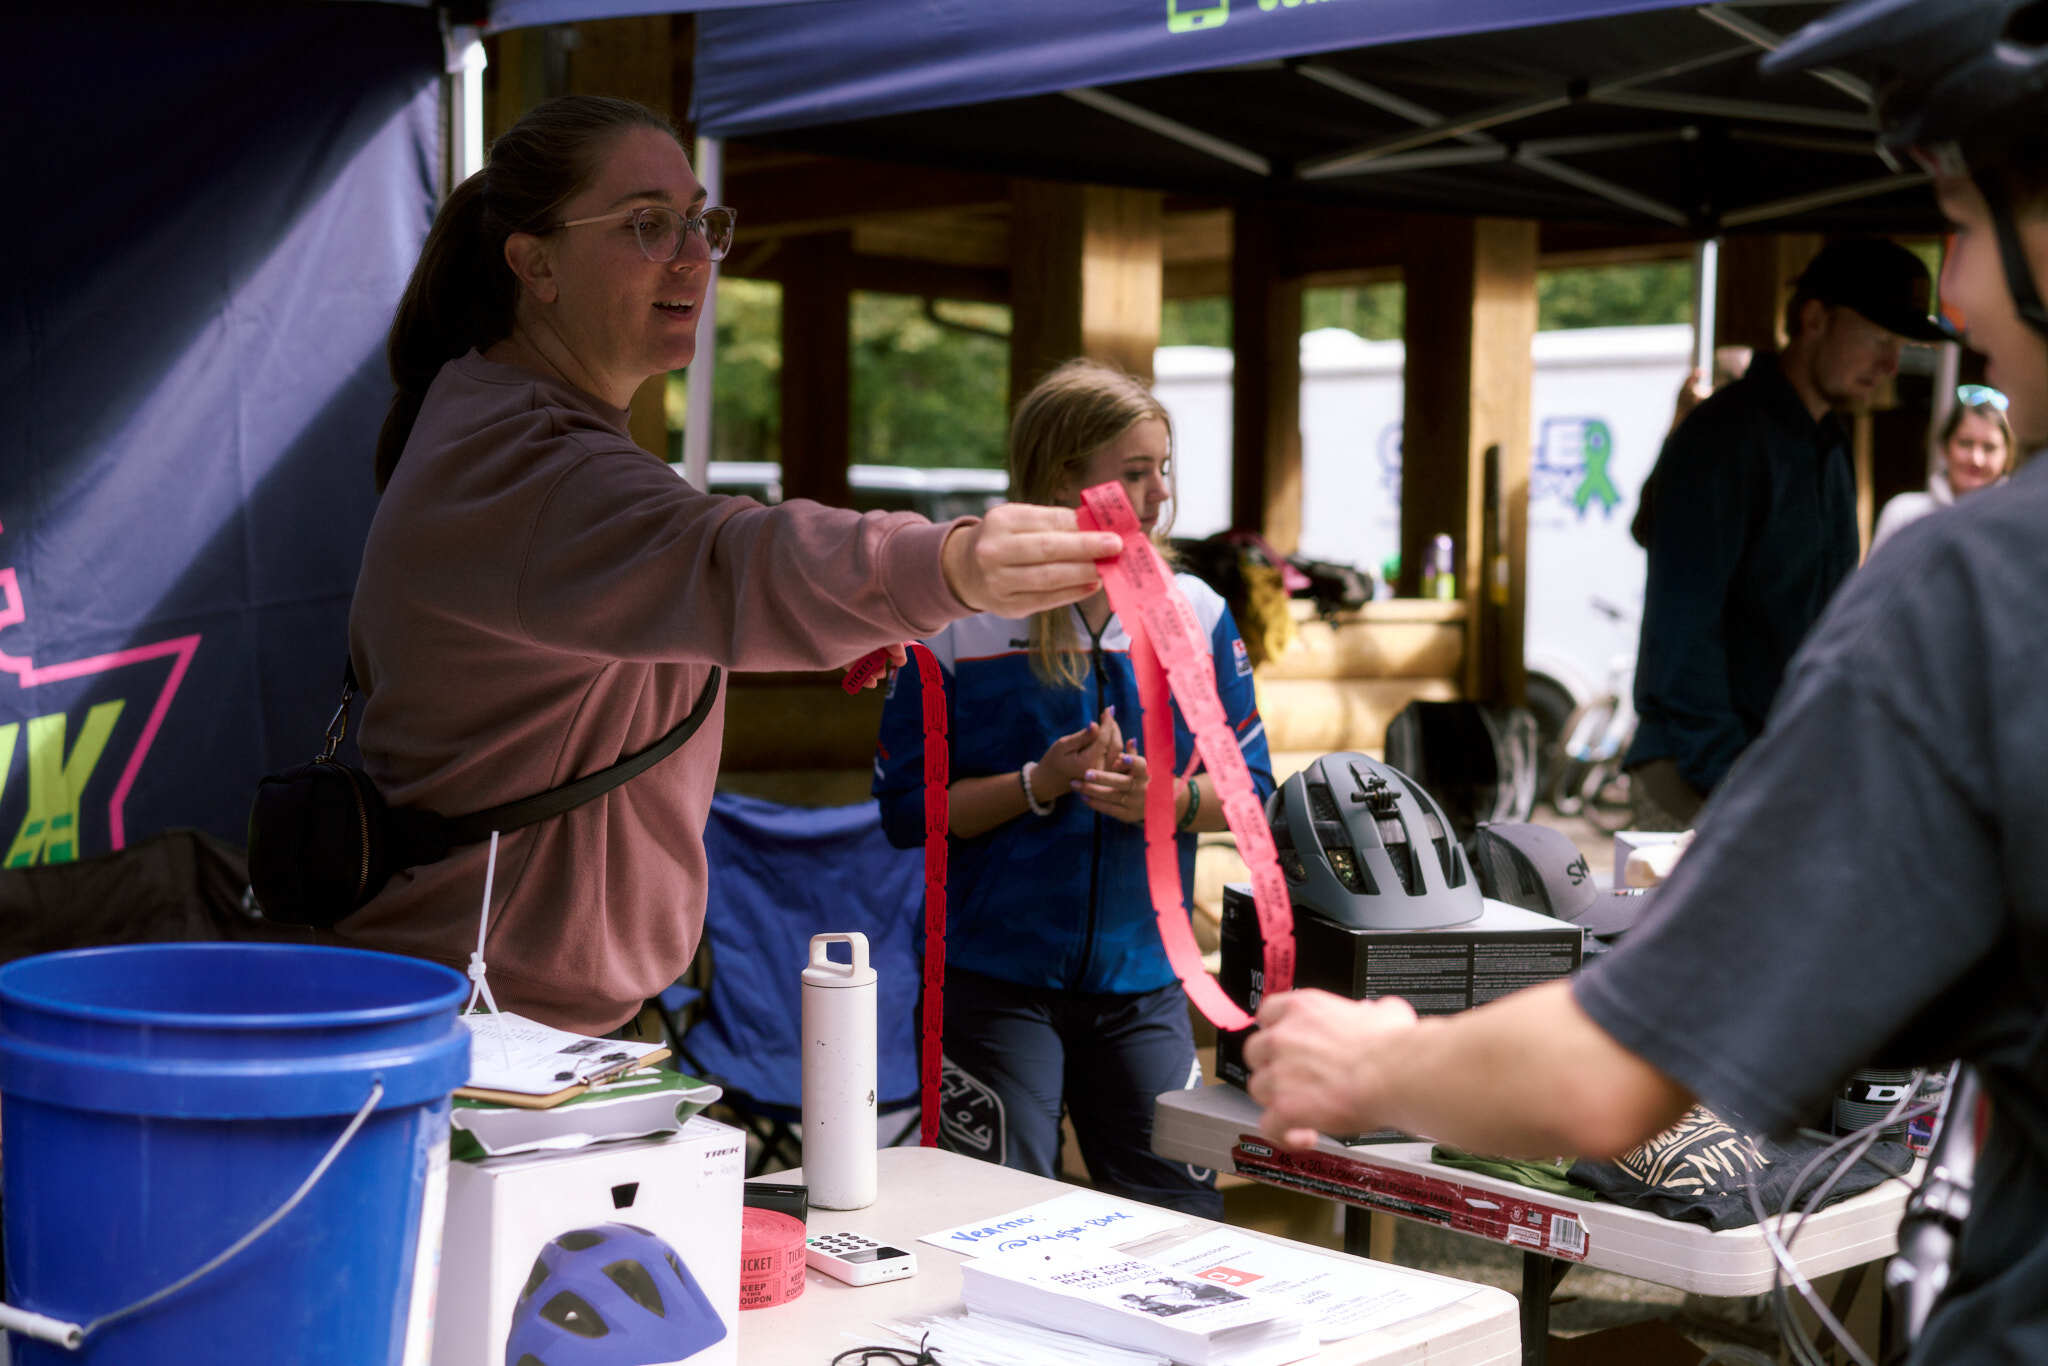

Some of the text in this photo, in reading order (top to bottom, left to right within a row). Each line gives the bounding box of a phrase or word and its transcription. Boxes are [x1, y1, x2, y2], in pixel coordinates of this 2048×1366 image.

[742, 1256, 772, 1272] ICKET
[741, 1283, 767, 1292] KEEP
[740, 1295, 772, 1305] OUPON
